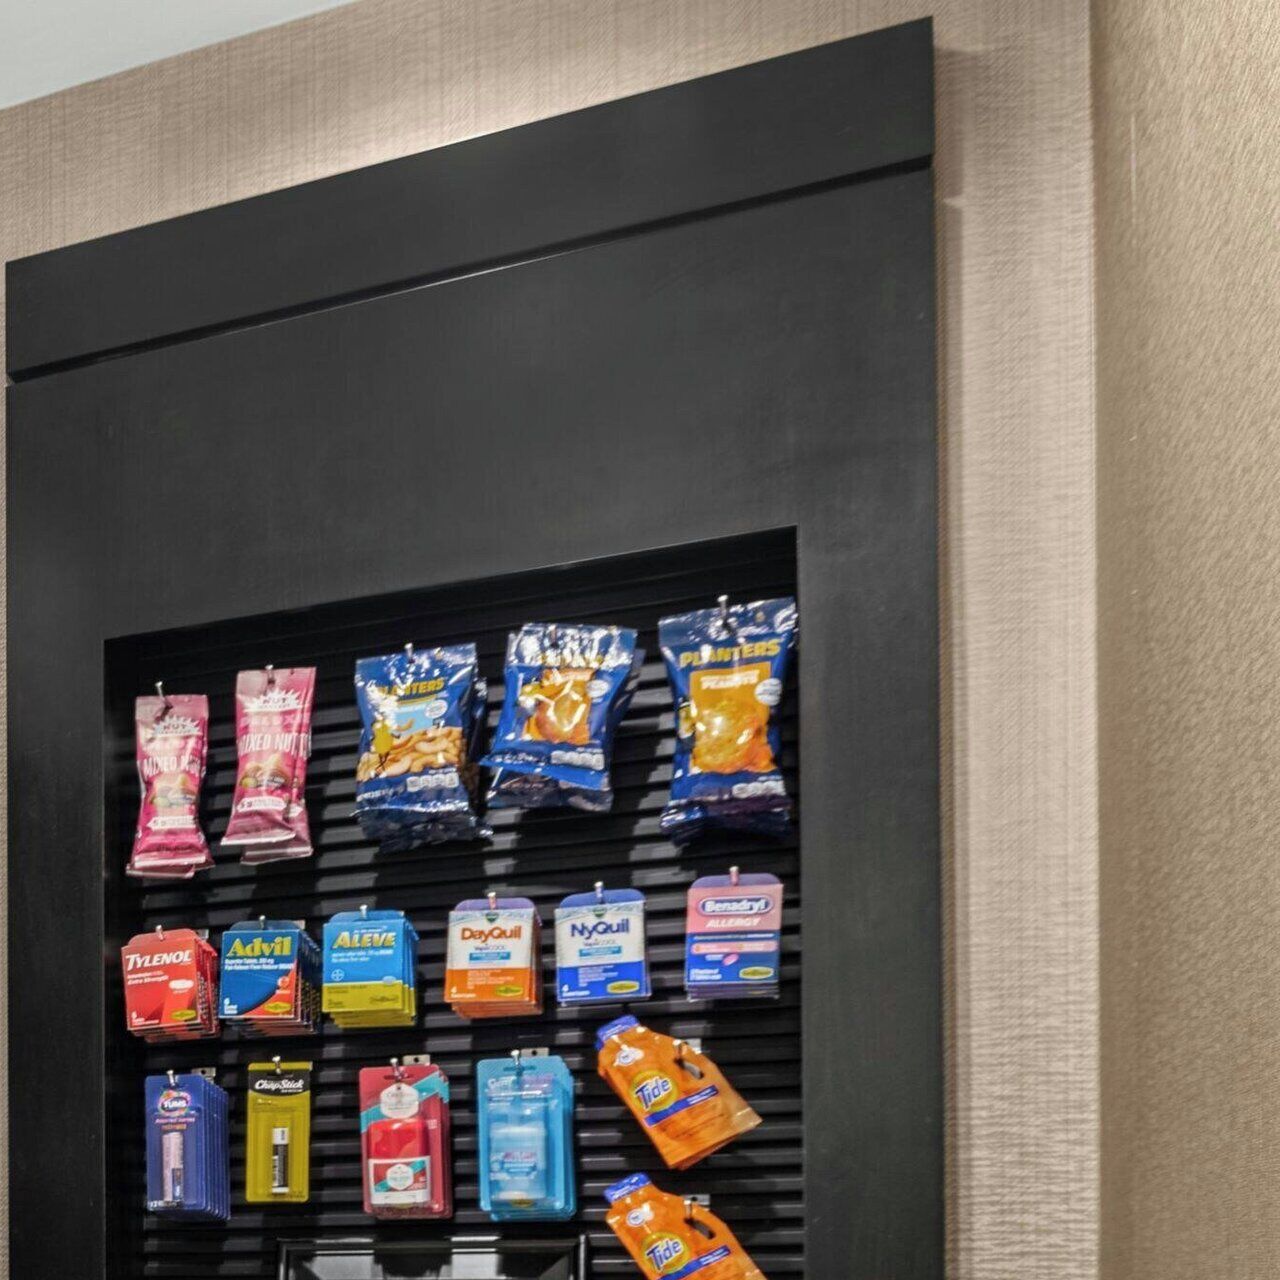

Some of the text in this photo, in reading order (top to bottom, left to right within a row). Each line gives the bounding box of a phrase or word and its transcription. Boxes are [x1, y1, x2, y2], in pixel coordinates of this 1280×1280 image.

[679, 639, 782, 668] PLANTERS
[704, 898, 767, 914] Benadryl
[570, 919, 630, 940] NyQuil
[706, 918, 761, 929] ALLERGY
[331, 931, 397, 949] ALEVE
[461, 926, 523, 943] DayQuil
[226, 936, 293, 957] Advil
[125, 949, 192, 971] TYLENOL
[254, 1078, 304, 1091] ChapStick
[635, 1076, 673, 1110] Tide
[645, 1236, 682, 1271] Tide
